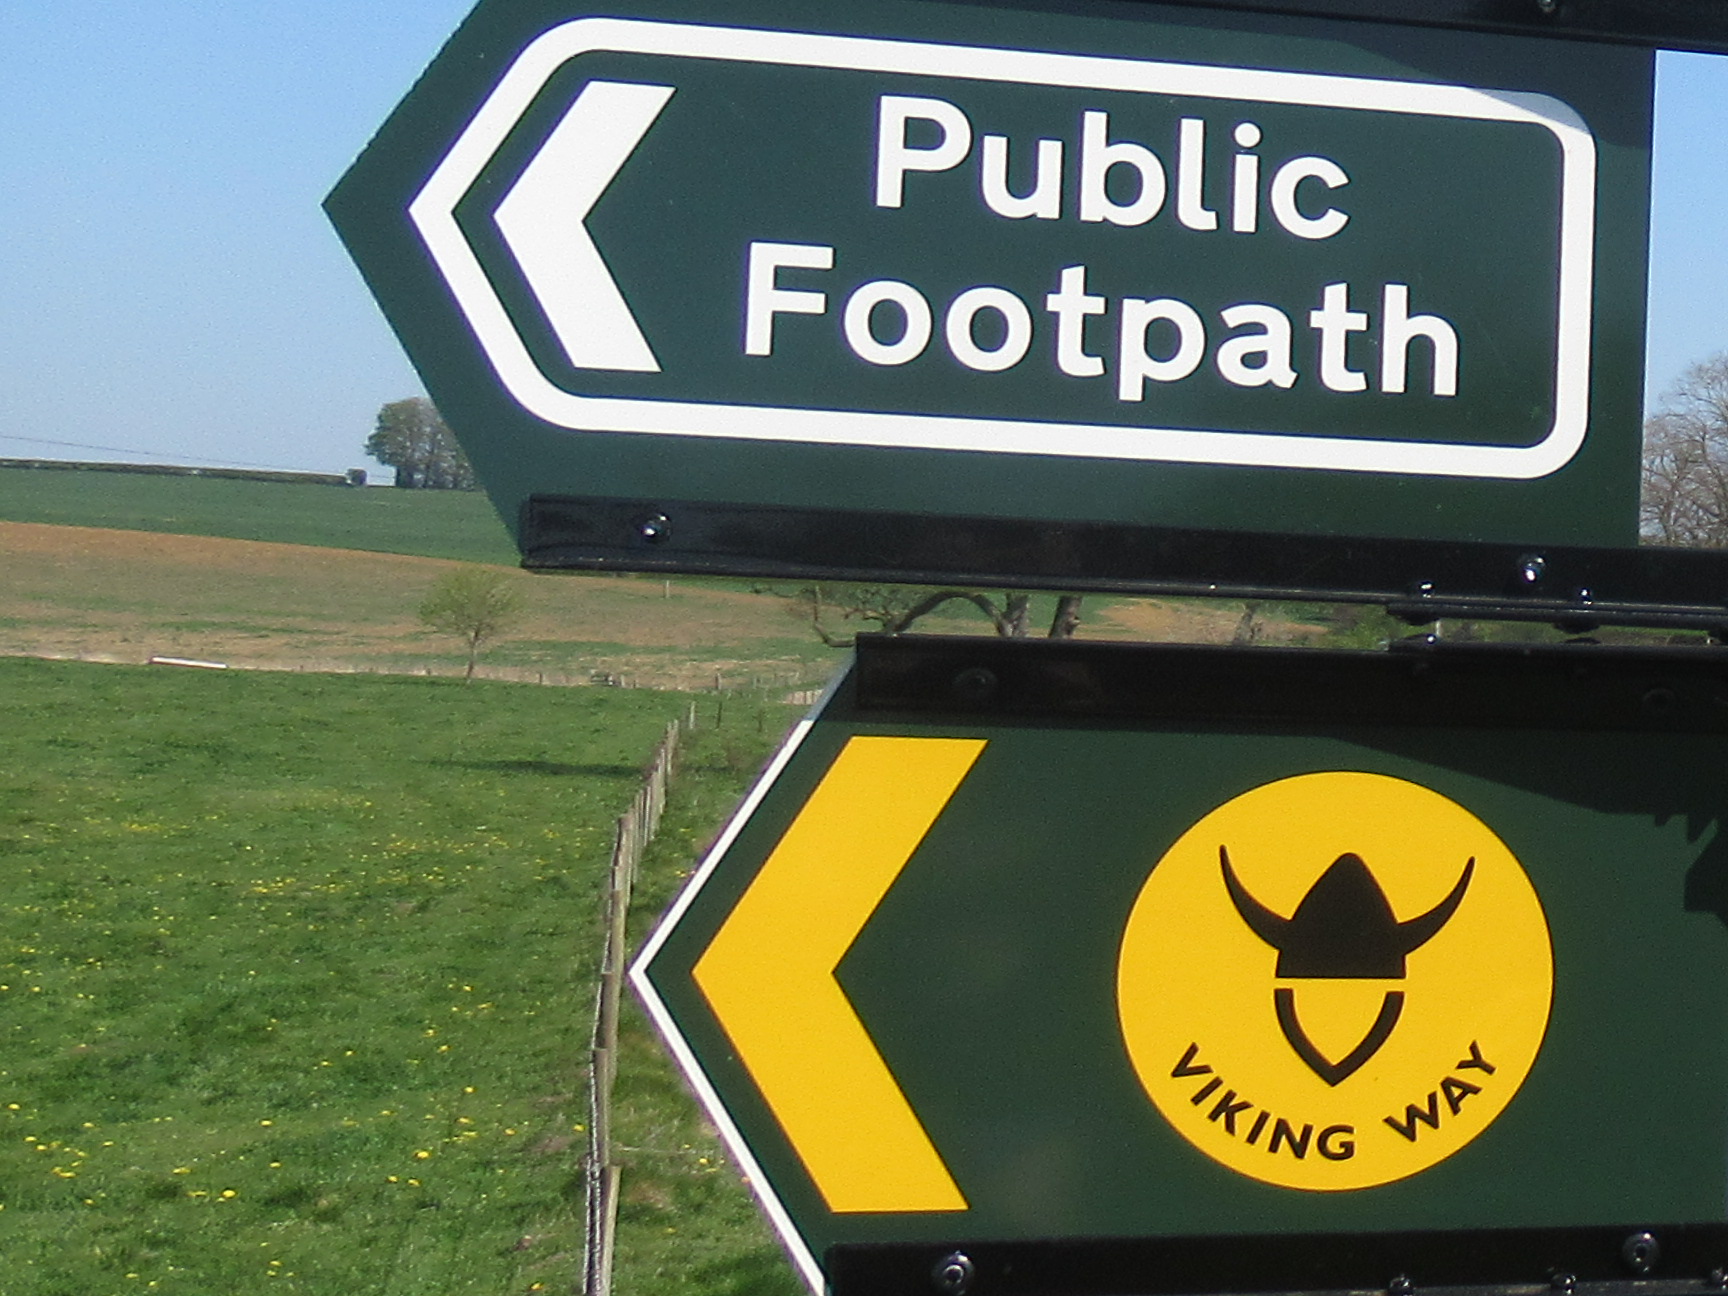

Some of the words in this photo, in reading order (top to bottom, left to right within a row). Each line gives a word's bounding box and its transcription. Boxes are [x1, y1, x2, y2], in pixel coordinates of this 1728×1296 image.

[874, 94, 1350, 241] Public
[744, 241, 1460, 403] Footpath
[1170, 1042, 1356, 1161] VIKING
[1383, 1039, 1497, 1144] WAY
